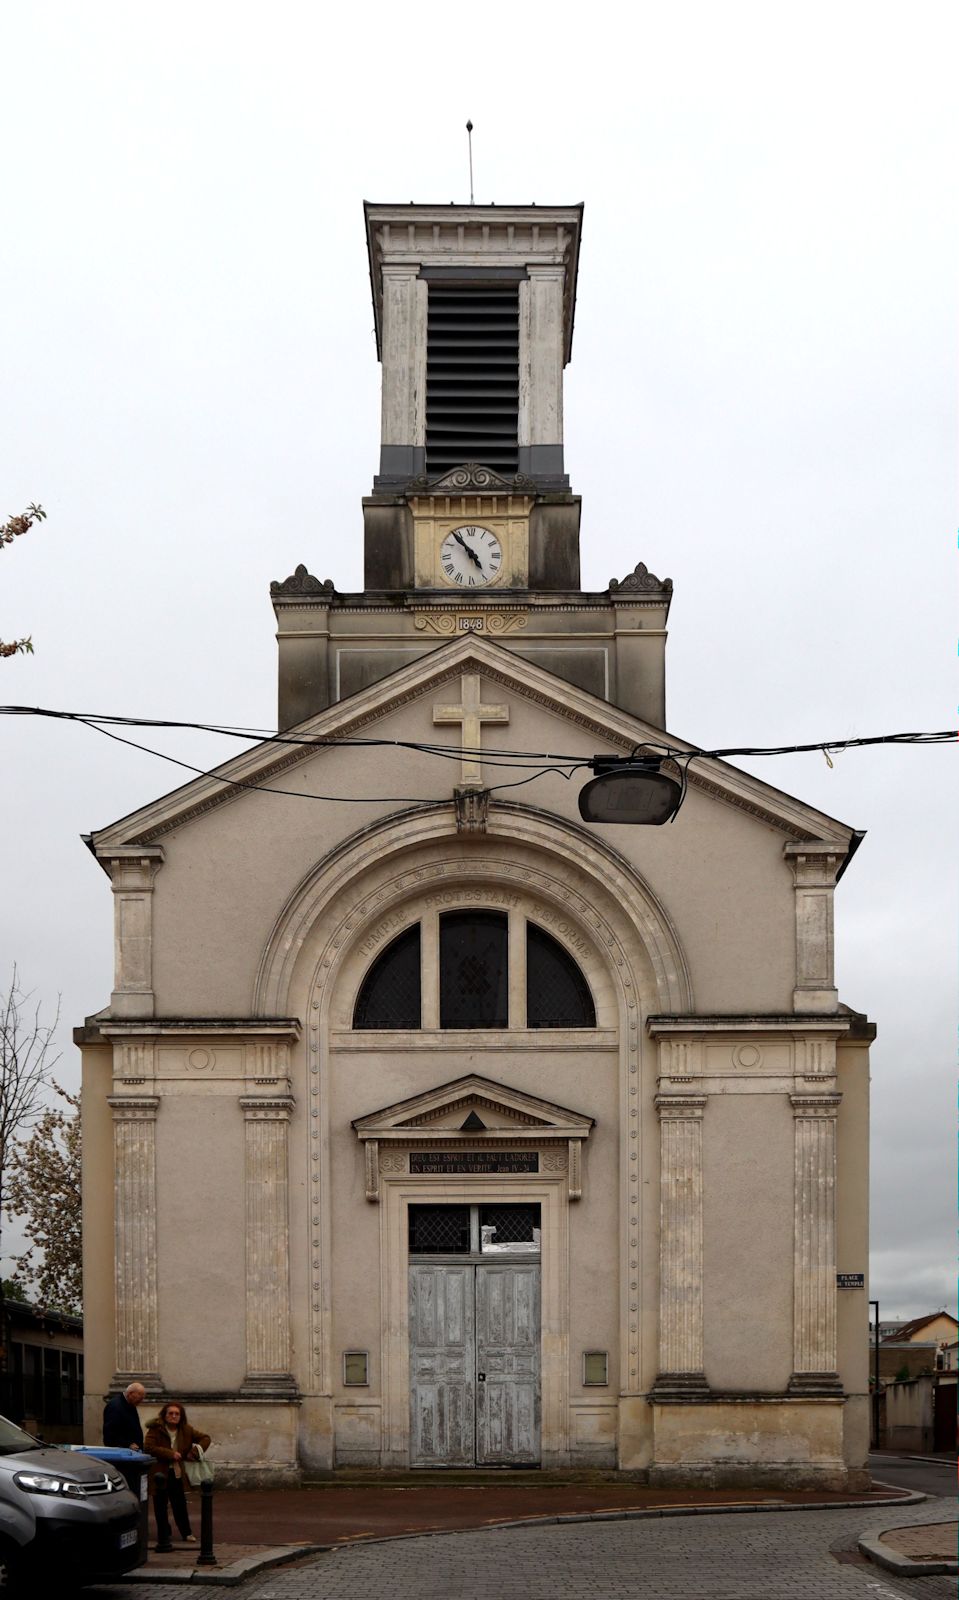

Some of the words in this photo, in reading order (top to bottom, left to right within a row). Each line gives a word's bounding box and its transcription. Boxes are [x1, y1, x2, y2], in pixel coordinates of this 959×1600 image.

[459, 618, 482, 630] 1848
[357, 910, 407, 956] TEMPLE
[424, 889, 522, 910] PROTESTANT
[497, 1164, 509, 1172] Jean
